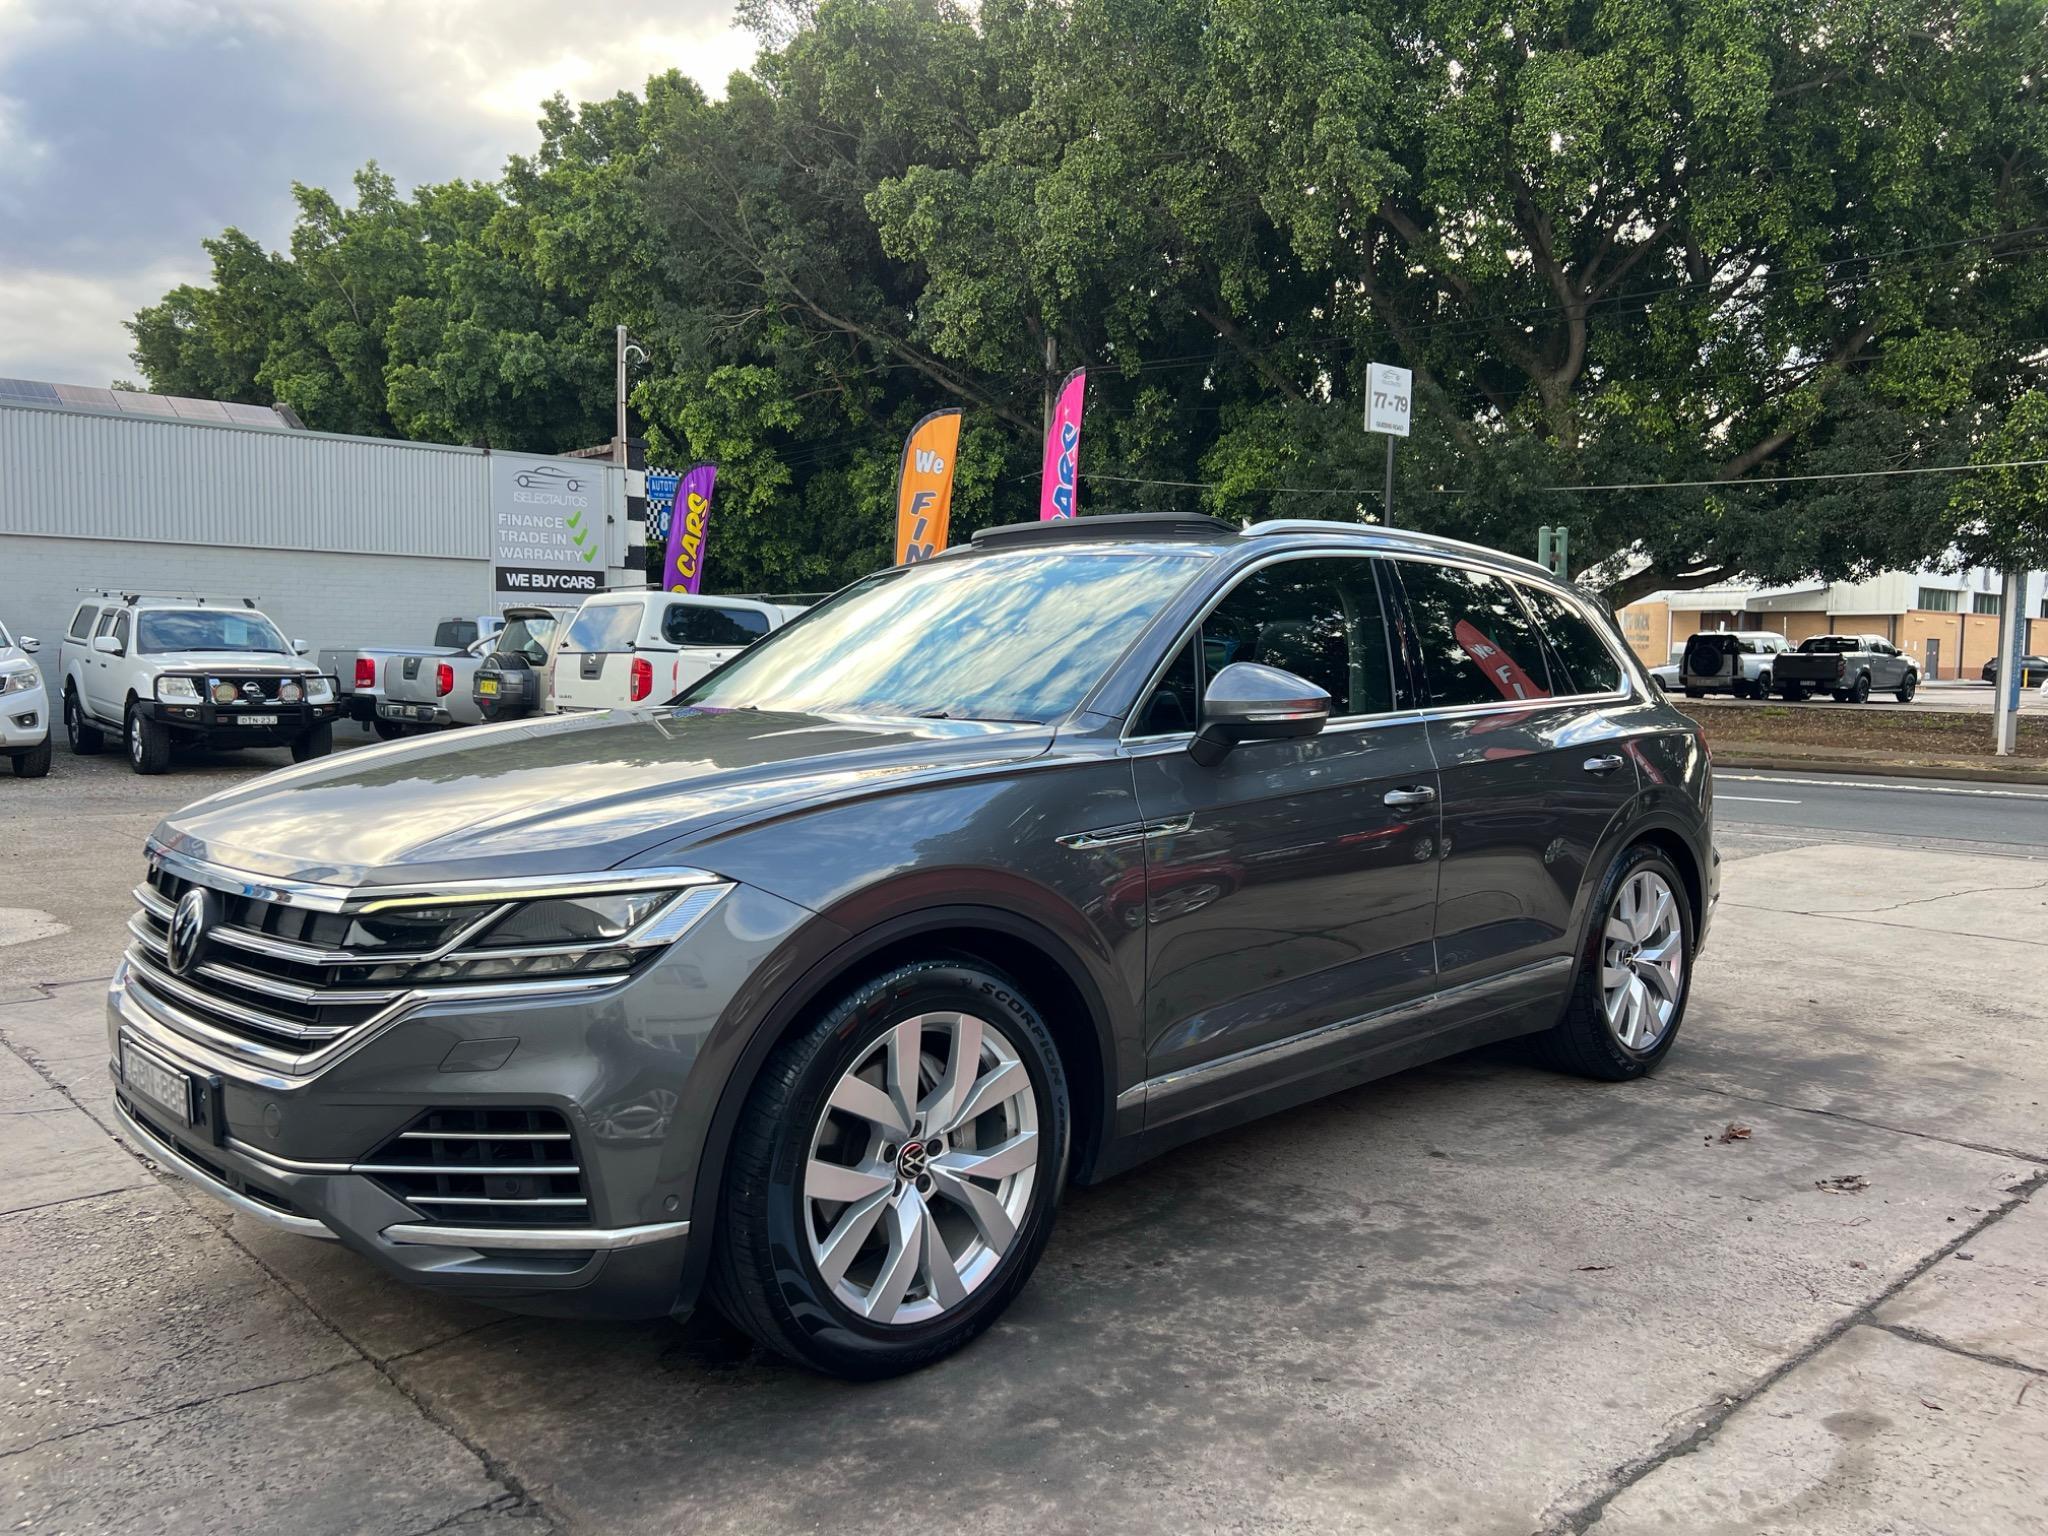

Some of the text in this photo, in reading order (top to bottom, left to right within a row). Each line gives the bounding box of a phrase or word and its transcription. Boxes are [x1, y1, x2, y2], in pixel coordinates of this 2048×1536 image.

[915, 449, 944, 474] We
[1051, 421, 1079, 520] ARS
[498, 513, 563, 528] FINANCE
[499, 530, 566, 545] TRADE IN
[677, 493, 708, 578] CARS
[499, 546, 582, 562] WARRANTY
[506, 573, 595, 589] WE BUY CARS
